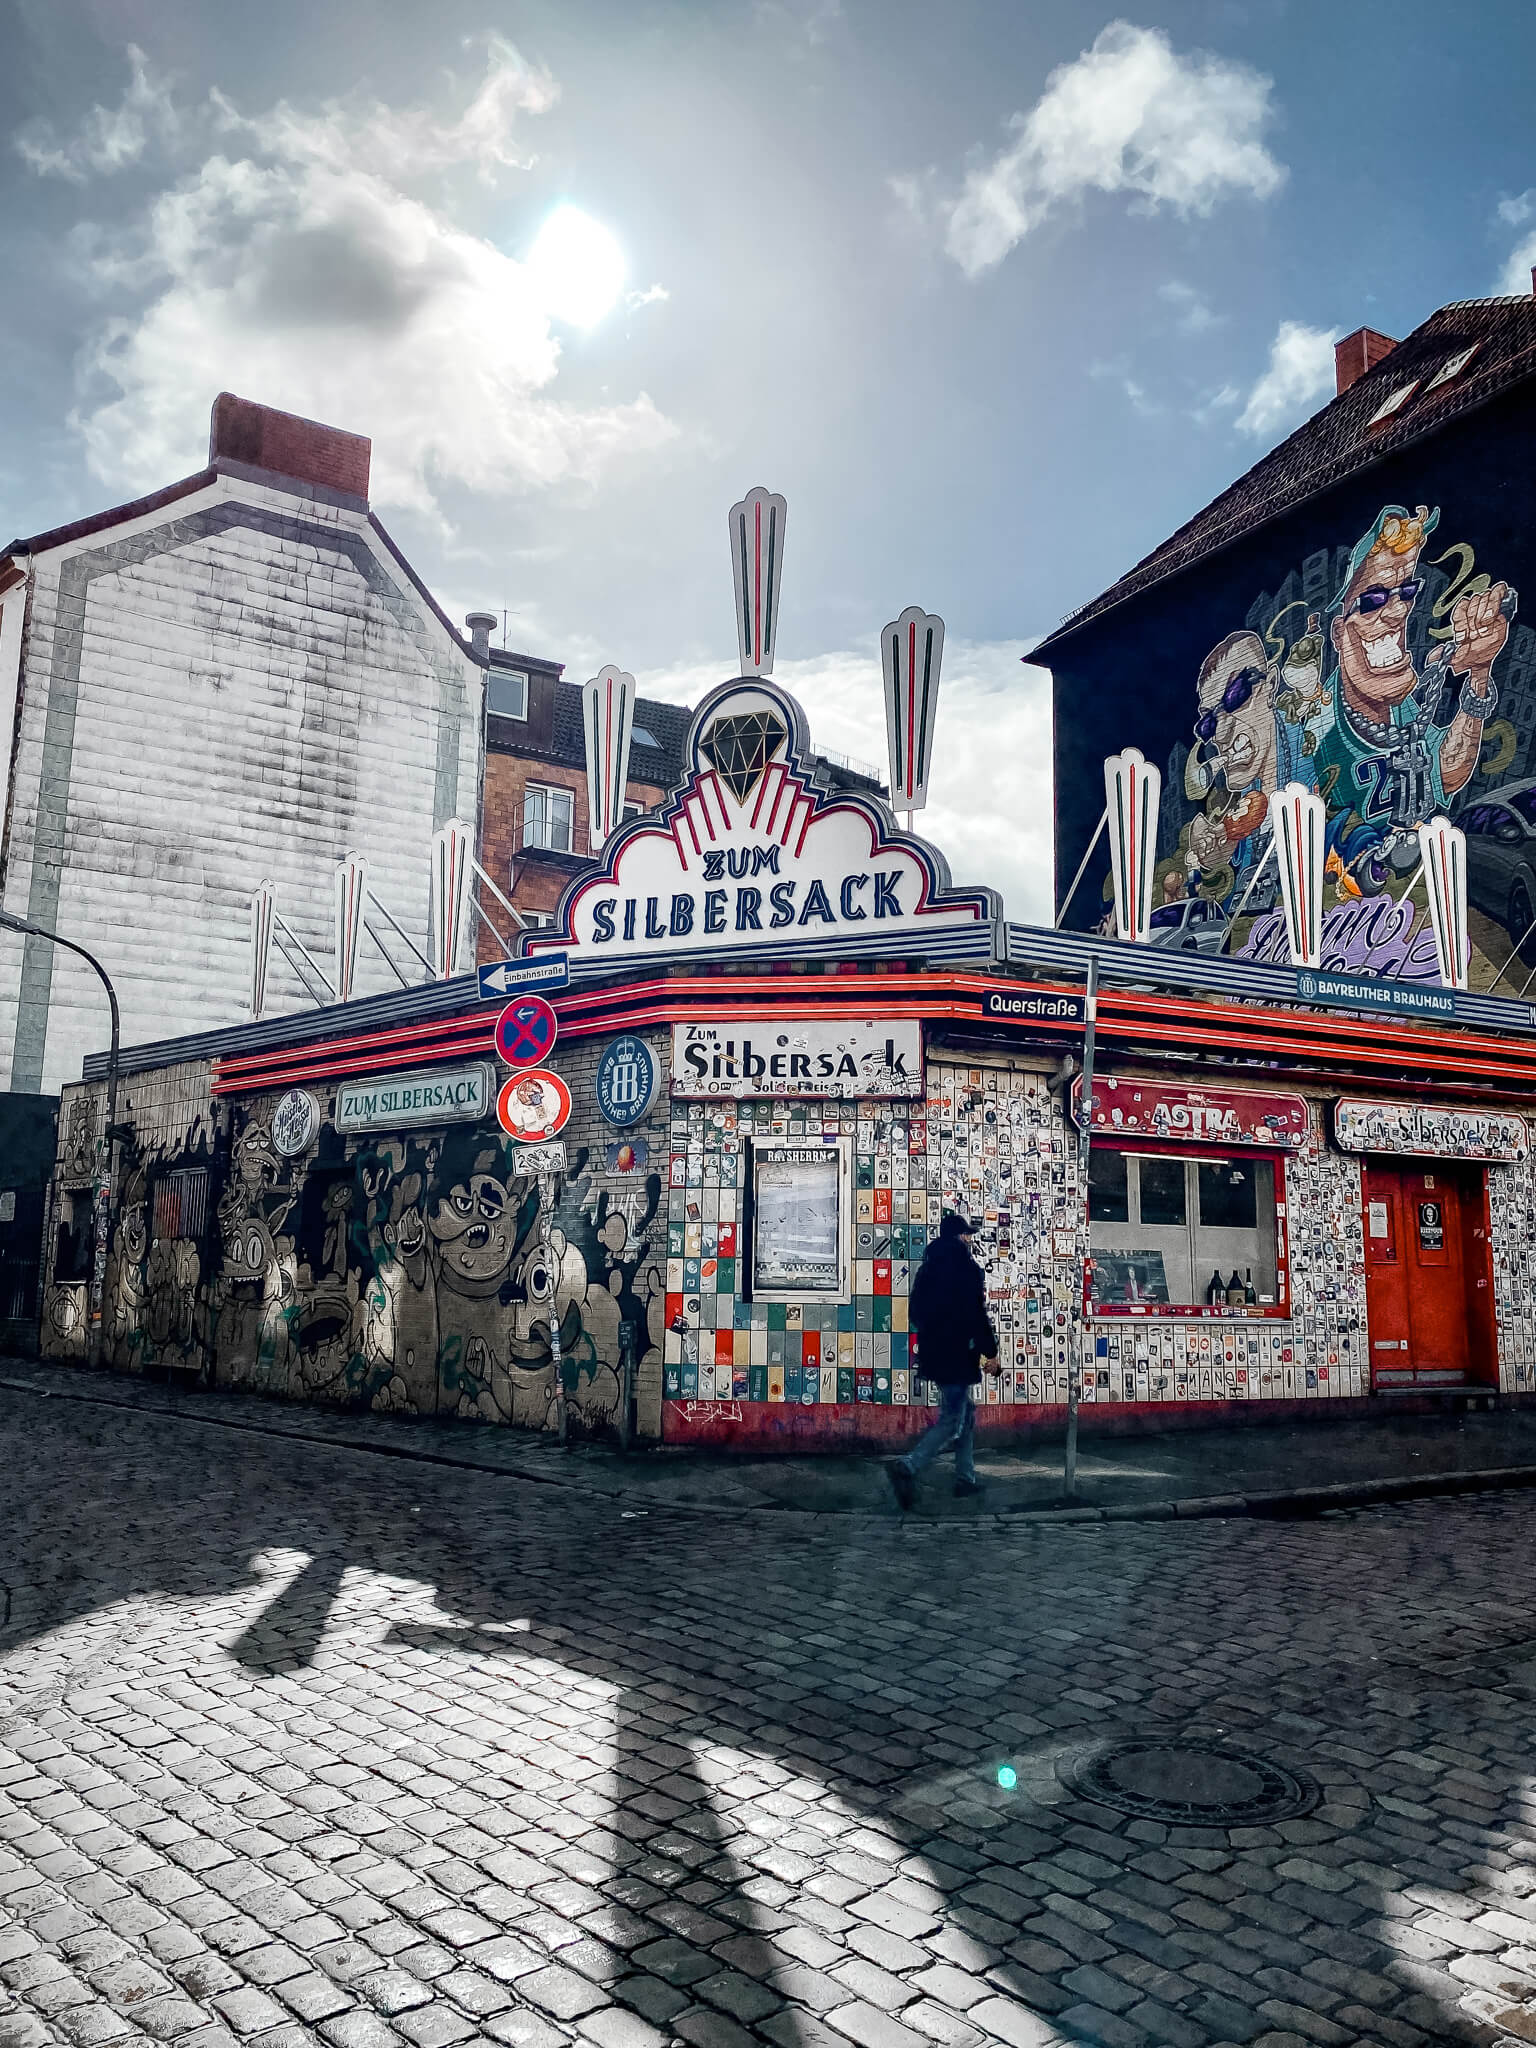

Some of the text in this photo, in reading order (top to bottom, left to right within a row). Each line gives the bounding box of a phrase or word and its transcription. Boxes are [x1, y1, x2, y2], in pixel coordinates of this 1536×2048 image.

[703, 844, 781, 881] ZUM
[592, 870, 904, 943] SILBERSACK
[503, 966, 563, 983] Einbahnstraße
[990, 994, 1078, 1016] Querstraße
[1318, 981, 1453, 1011] BAYREUTHER BRAUHAUS
[343, 1081, 478, 1117] ZUM SILBERSACK
[629, 1052, 649, 1116] BRAUHAUS
[1151, 1103, 1242, 1132] ASTRA
